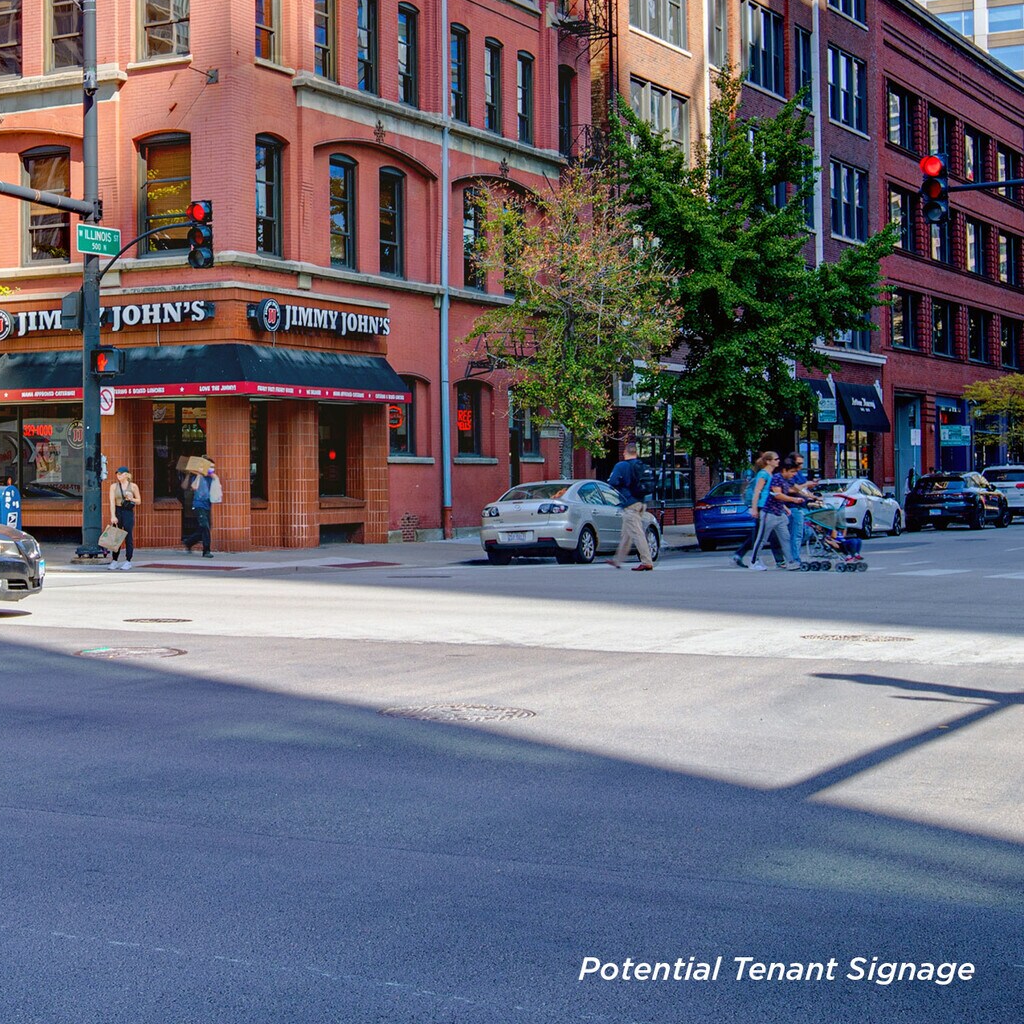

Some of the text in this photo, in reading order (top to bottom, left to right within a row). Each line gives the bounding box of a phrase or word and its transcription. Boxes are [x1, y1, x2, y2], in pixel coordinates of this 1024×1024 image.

[84, 229, 112, 243] ILLINOIS
[91, 242, 102, 251] 500
[112, 300, 206, 331] JOHN'S
[285, 305, 338, 330] JIMMY
[341, 312, 390, 336] JOHN'S
